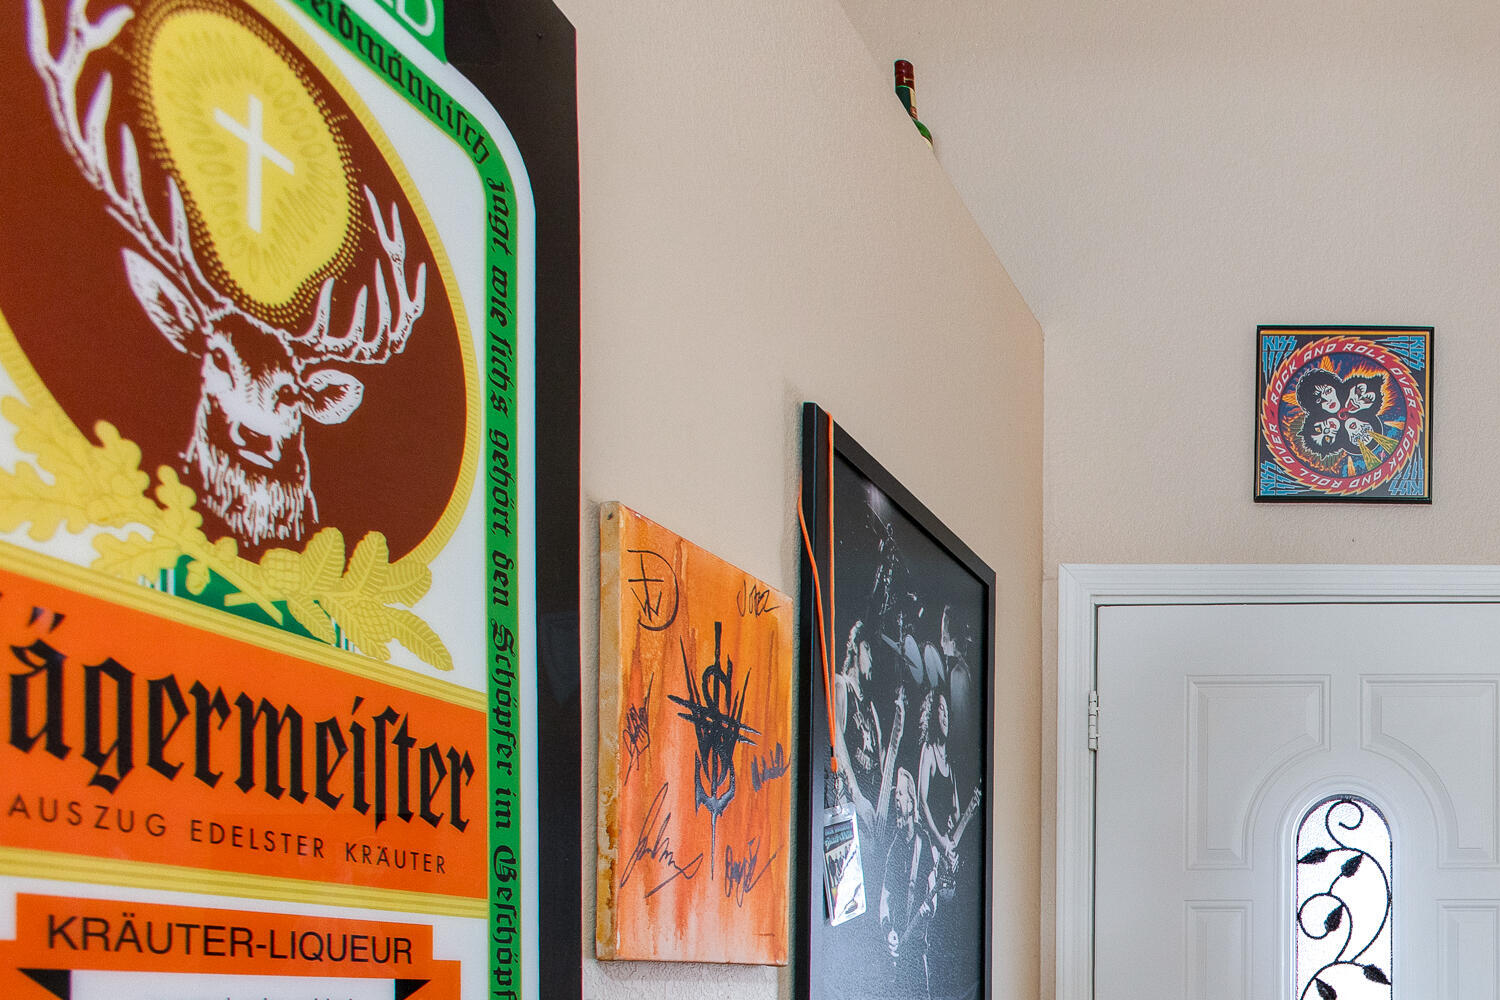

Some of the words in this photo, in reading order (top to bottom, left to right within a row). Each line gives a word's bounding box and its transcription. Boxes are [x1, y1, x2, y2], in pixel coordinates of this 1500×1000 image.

[491, 265, 513, 327] wie
[1263, 335, 1298, 351] KISS
[1409, 335, 1426, 371] KISS
[1270, 360, 1297, 406] ROCK
[1303, 343, 1337, 362] AND
[1343, 342, 1387, 364] ROLL
[1390, 367, 1417, 409] OVER
[1269, 424, 1296, 464] OVER
[1388, 426, 1416, 472] ROCK
[1299, 467, 1343, 489] ROLL
[1348, 468, 1383, 489] AND
[492, 549, 514, 607] den
[491, 620, 517, 776] Schöpfer
[494, 787, 516, 829] im
[8, 793, 168, 838] AUSZUG
[190, 818, 326, 860] EDELSTER
[345, 840, 448, 876] KRÄUTER
[48, 912, 414, 966] KRÄUTER-LIQUEUR
